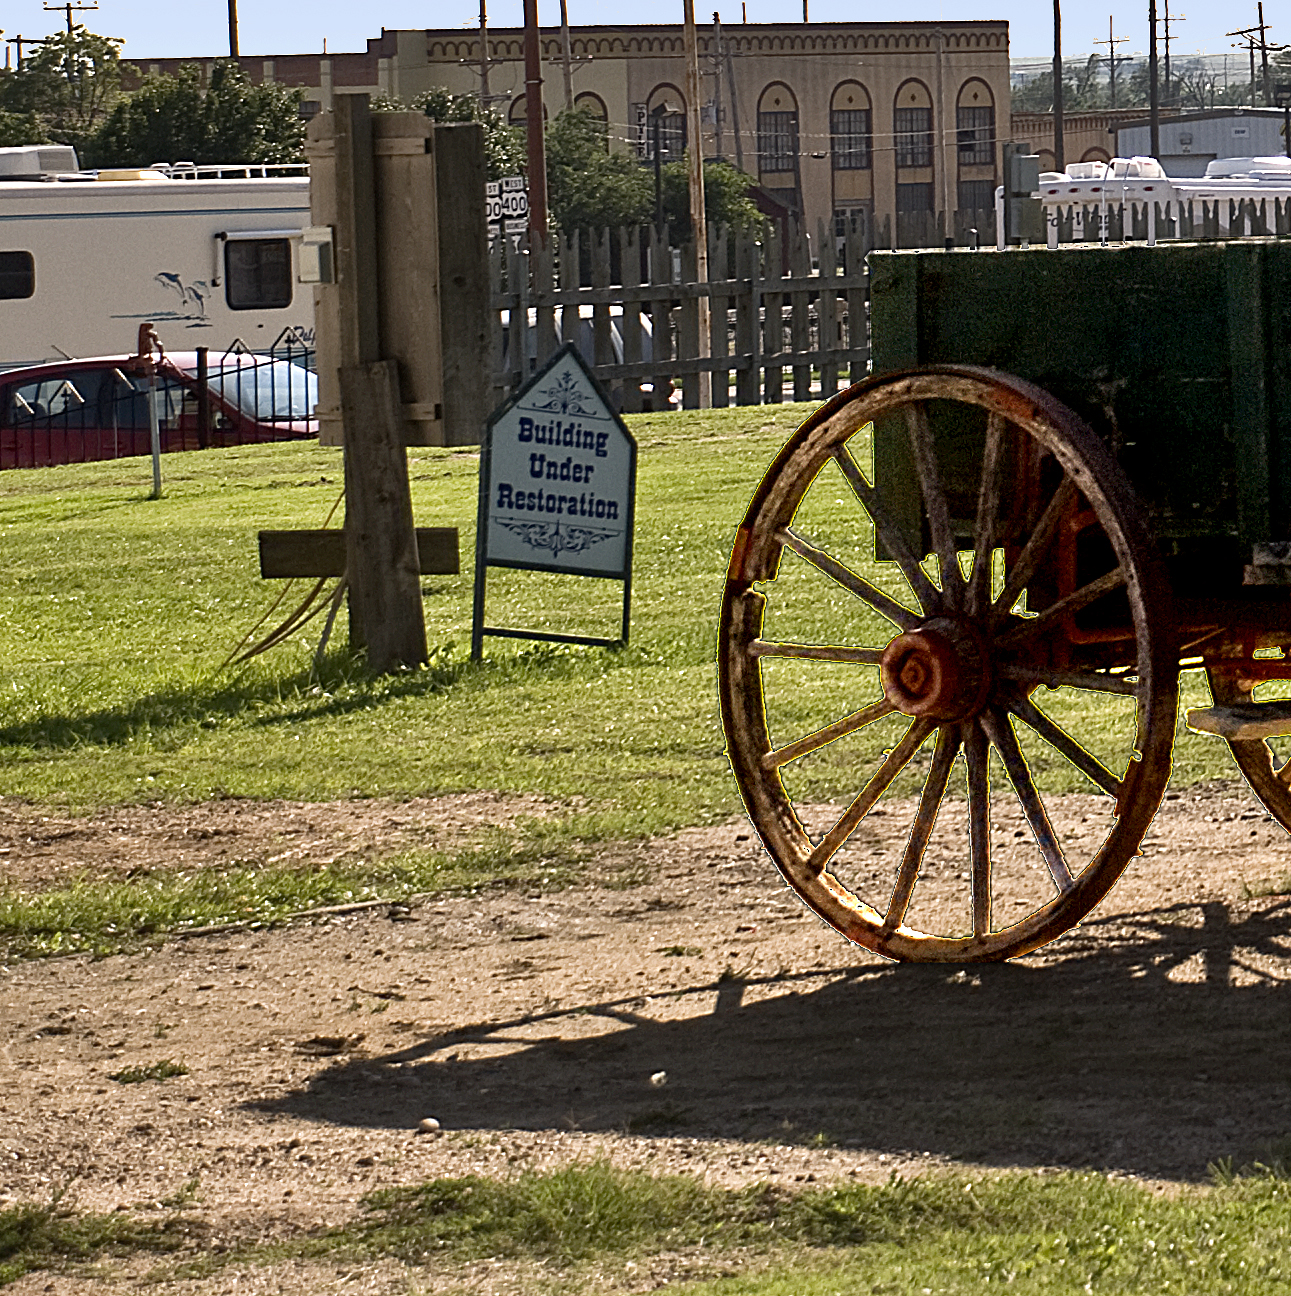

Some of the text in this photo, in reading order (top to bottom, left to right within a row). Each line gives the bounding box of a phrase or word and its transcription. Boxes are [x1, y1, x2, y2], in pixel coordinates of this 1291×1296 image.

[504, 179, 522, 188] WEST
[502, 196, 527, 212] 400
[517, 416, 609, 458] Building
[529, 452, 595, 484] Under
[496, 482, 620, 521] Restoration
